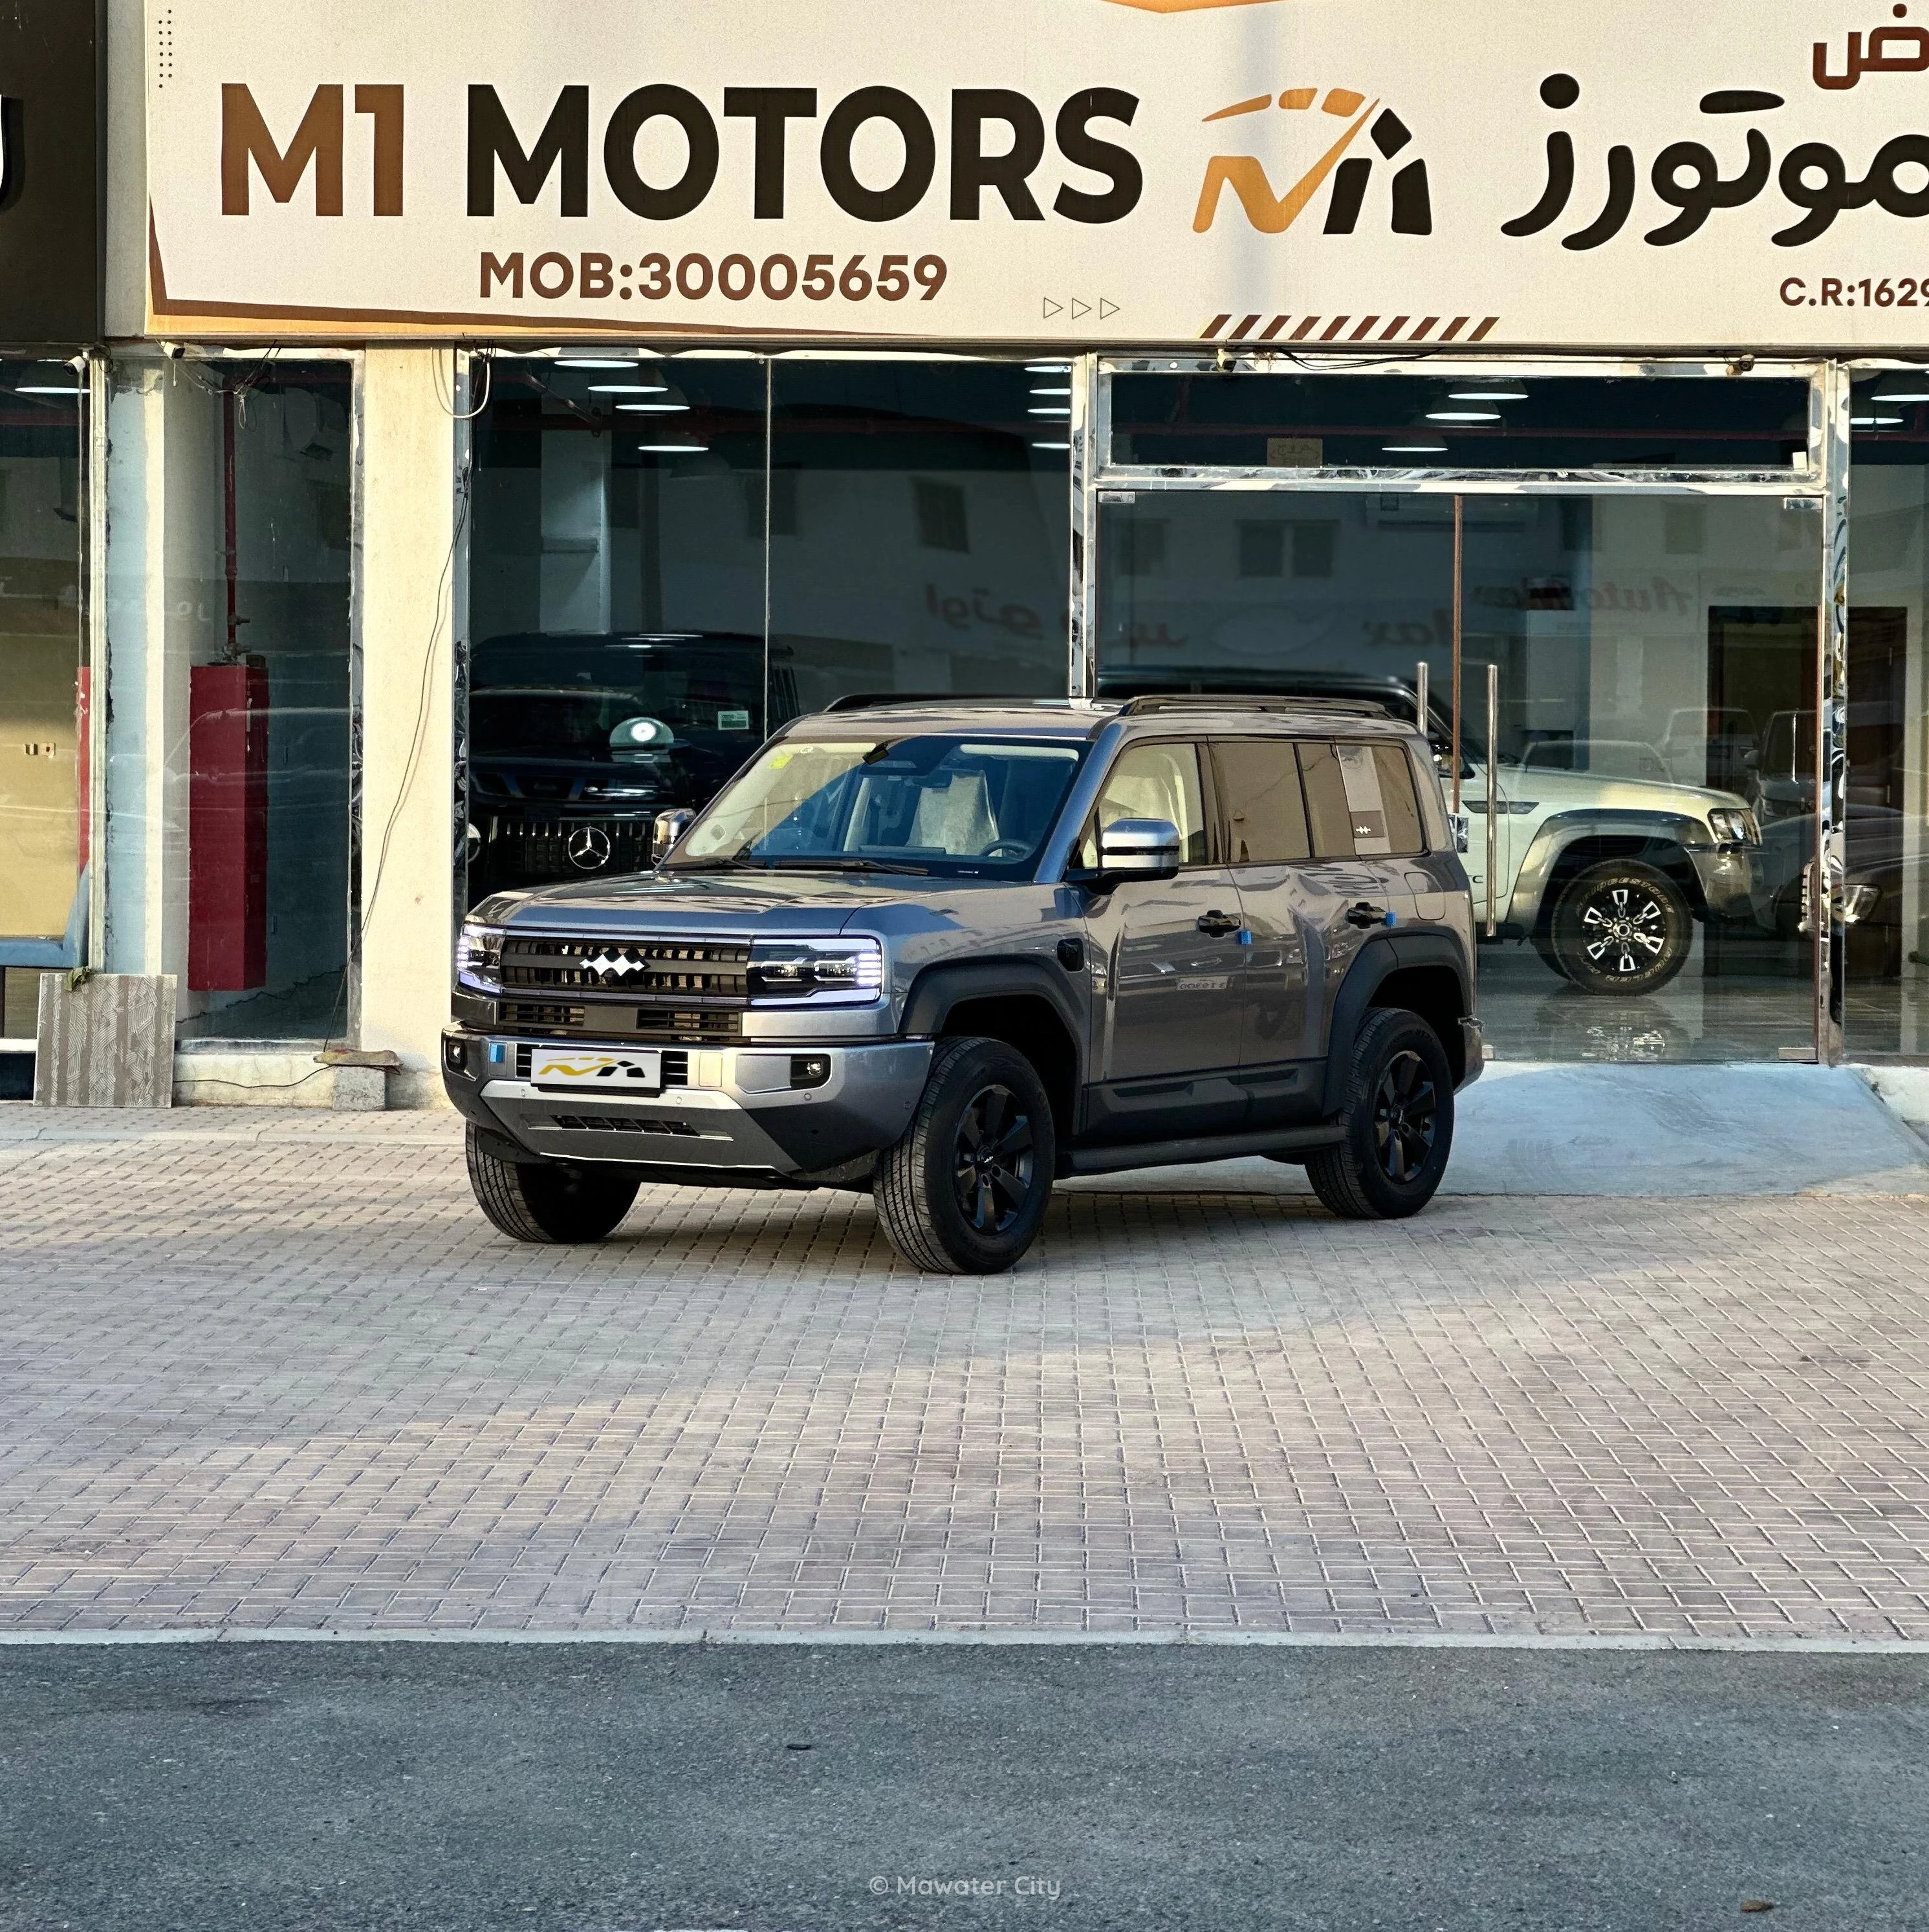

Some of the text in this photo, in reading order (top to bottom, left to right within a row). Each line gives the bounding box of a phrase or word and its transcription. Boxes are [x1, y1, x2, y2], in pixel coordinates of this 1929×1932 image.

[221, 83, 1143, 224] M1 MOTORS
[479, 252, 948, 301] MOB:30005659
